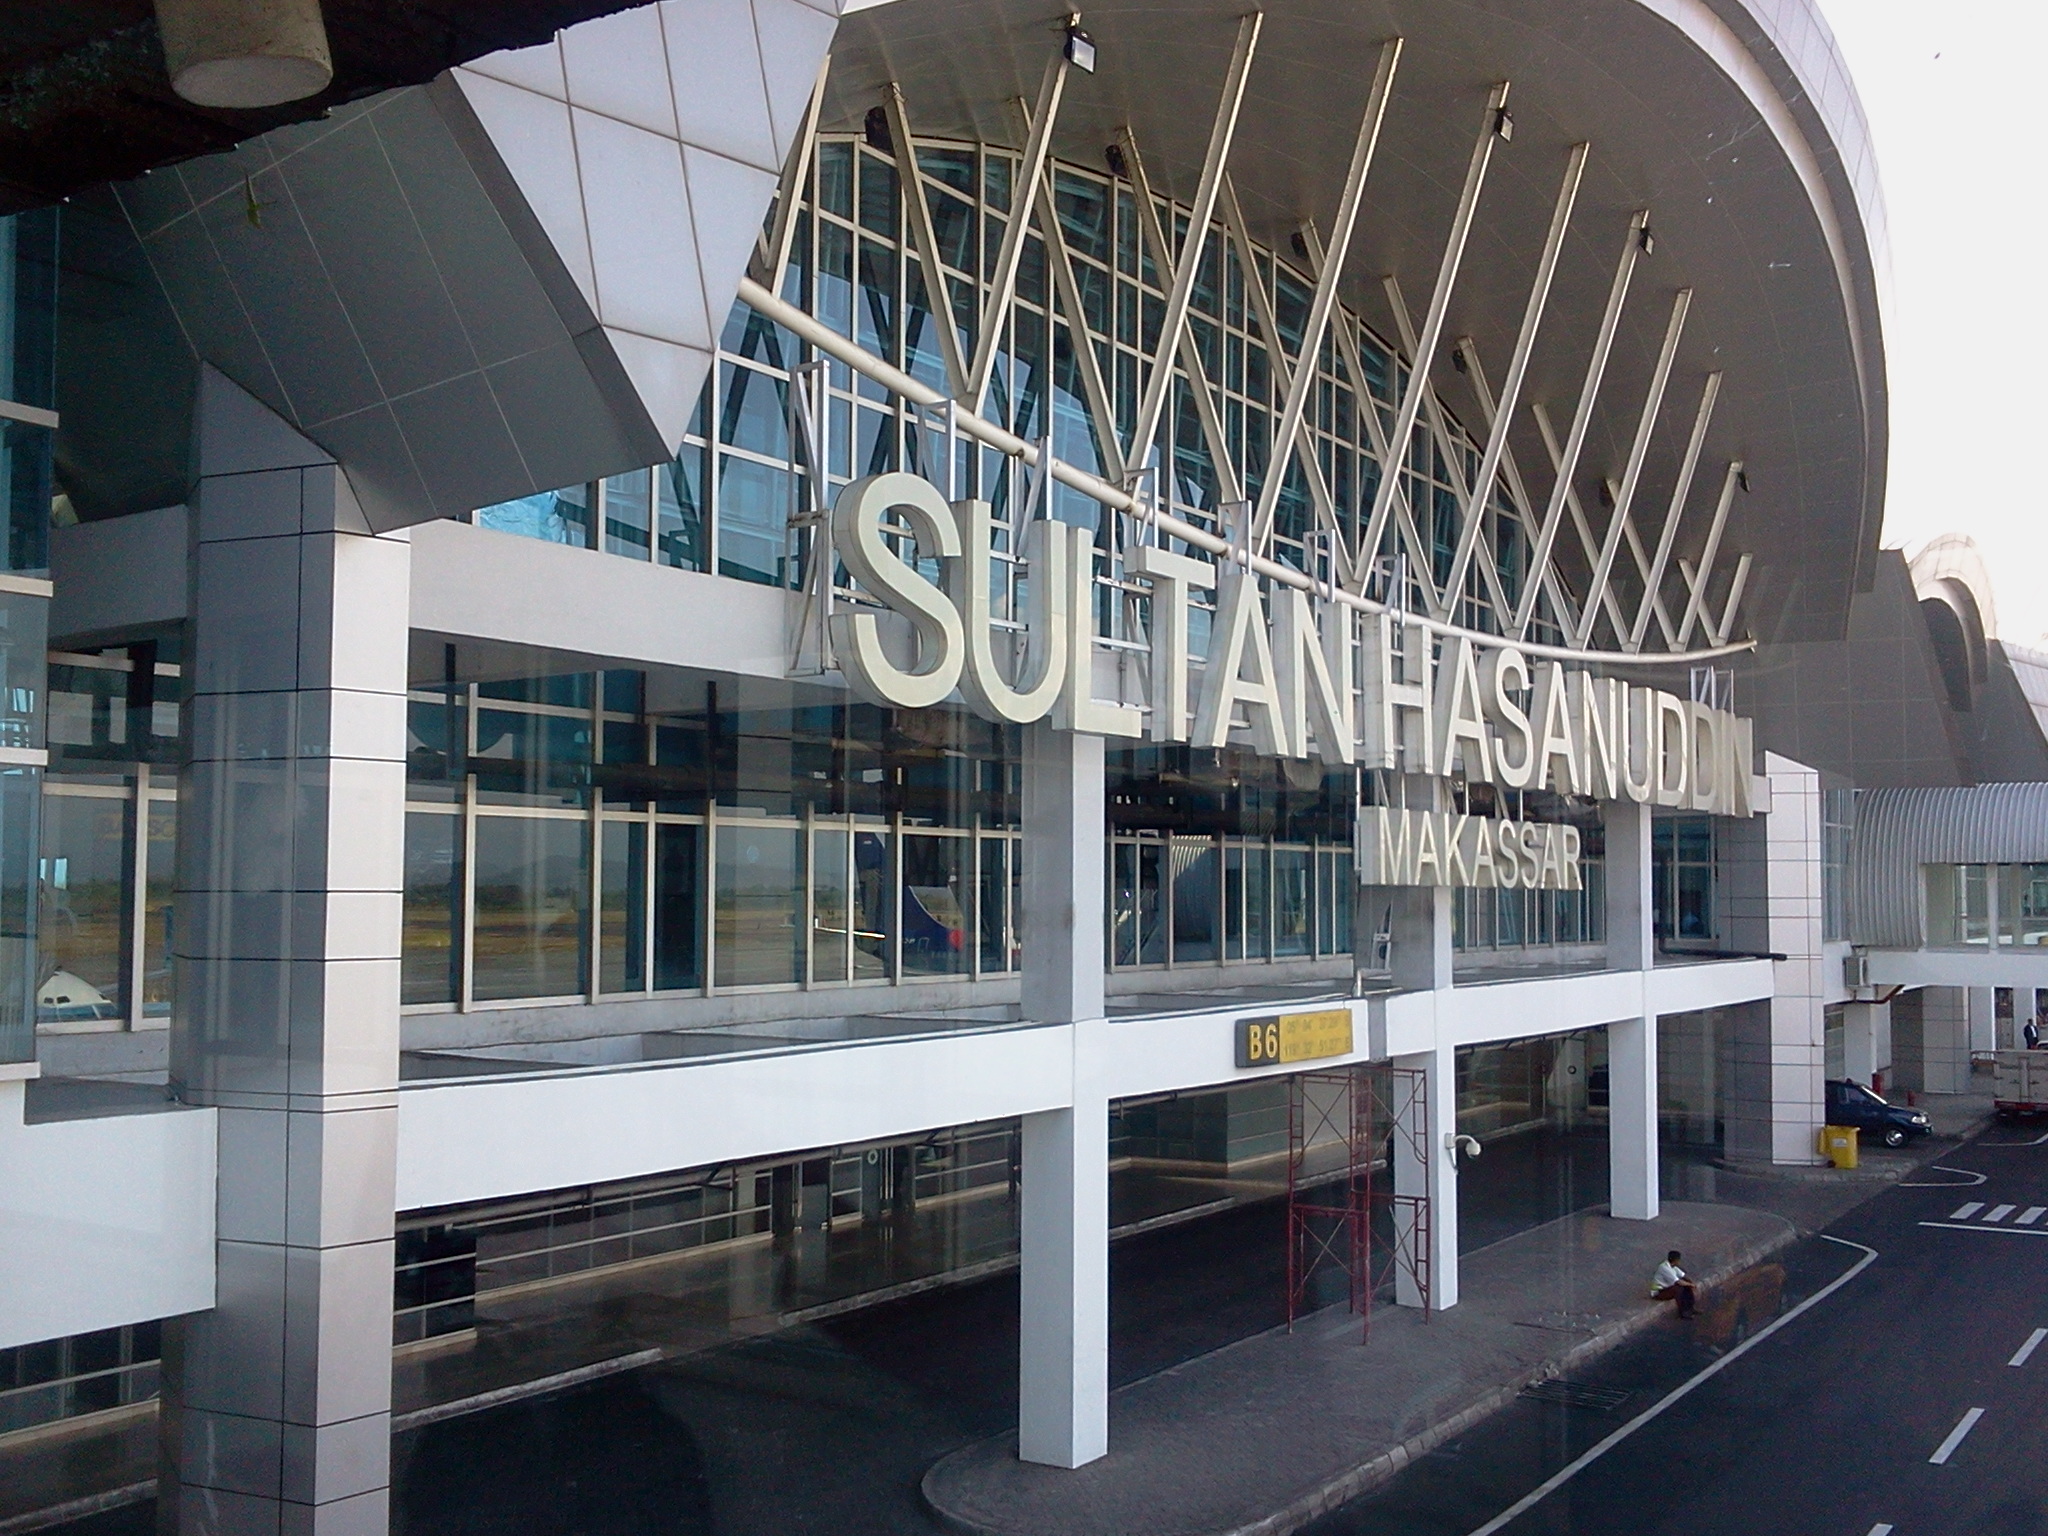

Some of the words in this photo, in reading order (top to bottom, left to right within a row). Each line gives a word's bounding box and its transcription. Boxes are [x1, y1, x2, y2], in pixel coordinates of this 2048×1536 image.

[831, 472, 1354, 764] SULTAN
[1362, 613, 1755, 818] HASANUDDIN
[1361, 806, 1583, 891] MAKASSAR
[1249, 1023, 1278, 1061] B6
